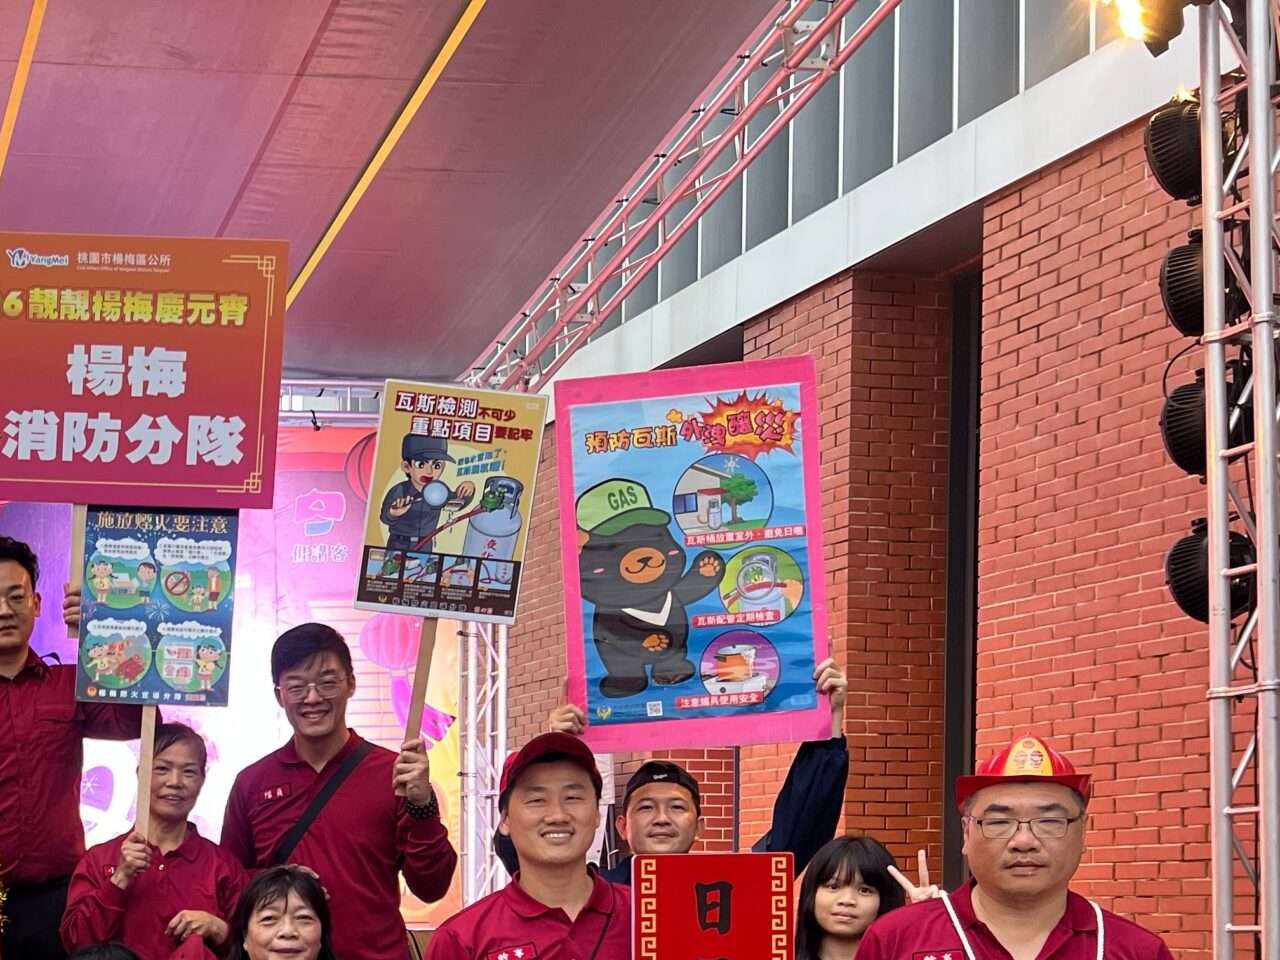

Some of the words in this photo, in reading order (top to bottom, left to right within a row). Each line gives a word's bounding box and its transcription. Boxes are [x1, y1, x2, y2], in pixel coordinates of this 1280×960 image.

[77, 251, 171, 267] 桃園市楊梅區公所
[66, 343, 188, 398] 楊梅
[2, 410, 247, 467] 消防分隊
[608, 486, 638, 511] GAS
[97, 511, 229, 534] 施放煙火要注意
